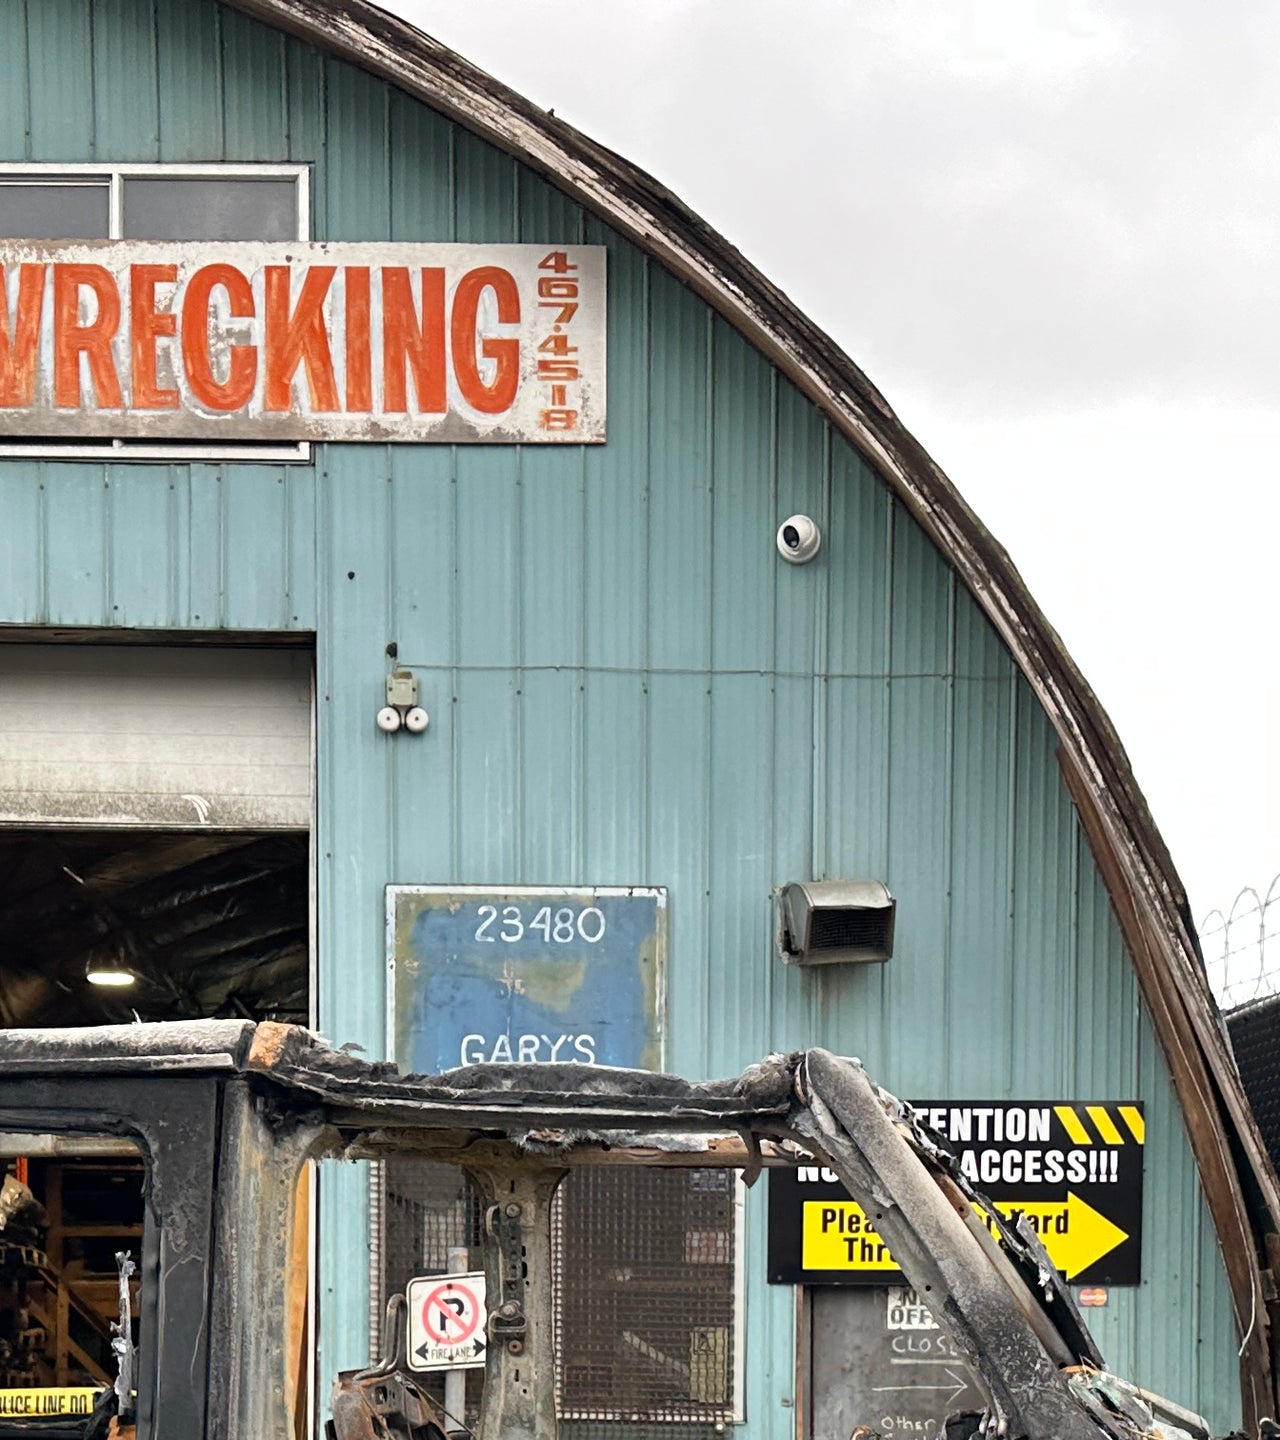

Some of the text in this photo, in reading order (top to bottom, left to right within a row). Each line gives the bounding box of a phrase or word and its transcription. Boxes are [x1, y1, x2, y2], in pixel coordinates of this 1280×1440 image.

[475, 905, 606, 944] 23480
[461, 1034, 596, 1068] GARY'S
[960, 1149, 1119, 1183] ACCESS!!!
[431, 1346, 472, 1360] FIRE LANE
[36, 1395, 66, 1414] LINE
[881, 1416, 937, 1431] Other
